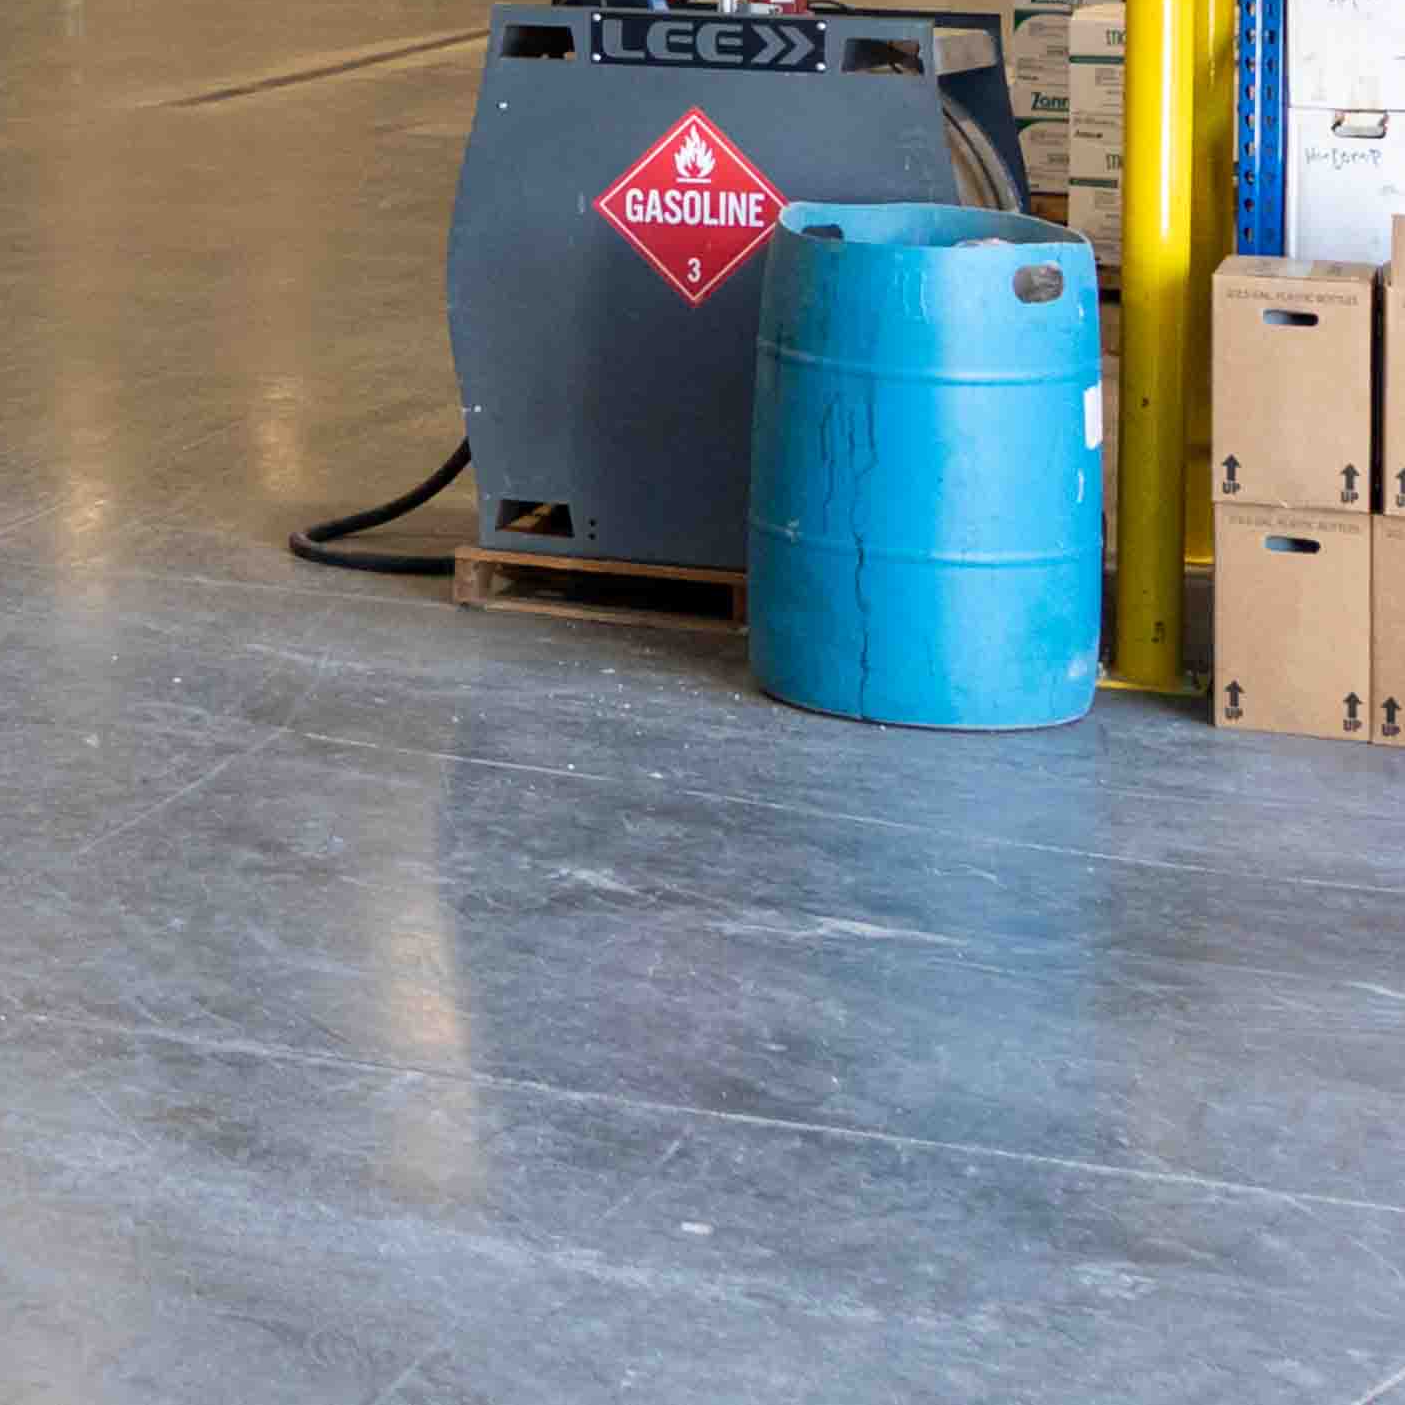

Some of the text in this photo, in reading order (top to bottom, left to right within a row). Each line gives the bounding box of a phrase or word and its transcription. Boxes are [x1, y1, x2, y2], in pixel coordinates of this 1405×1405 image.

[602, 19, 743, 63] LEE
[625, 187, 766, 228] GASOLINE
[687, 257, 701, 283] 3
[1222, 482, 1240, 494] UP
[1341, 491, 1359, 503] UP
[1225, 708, 1243, 720] UP
[1343, 719, 1363, 732] UP
[1382, 724, 1401, 737] UP
